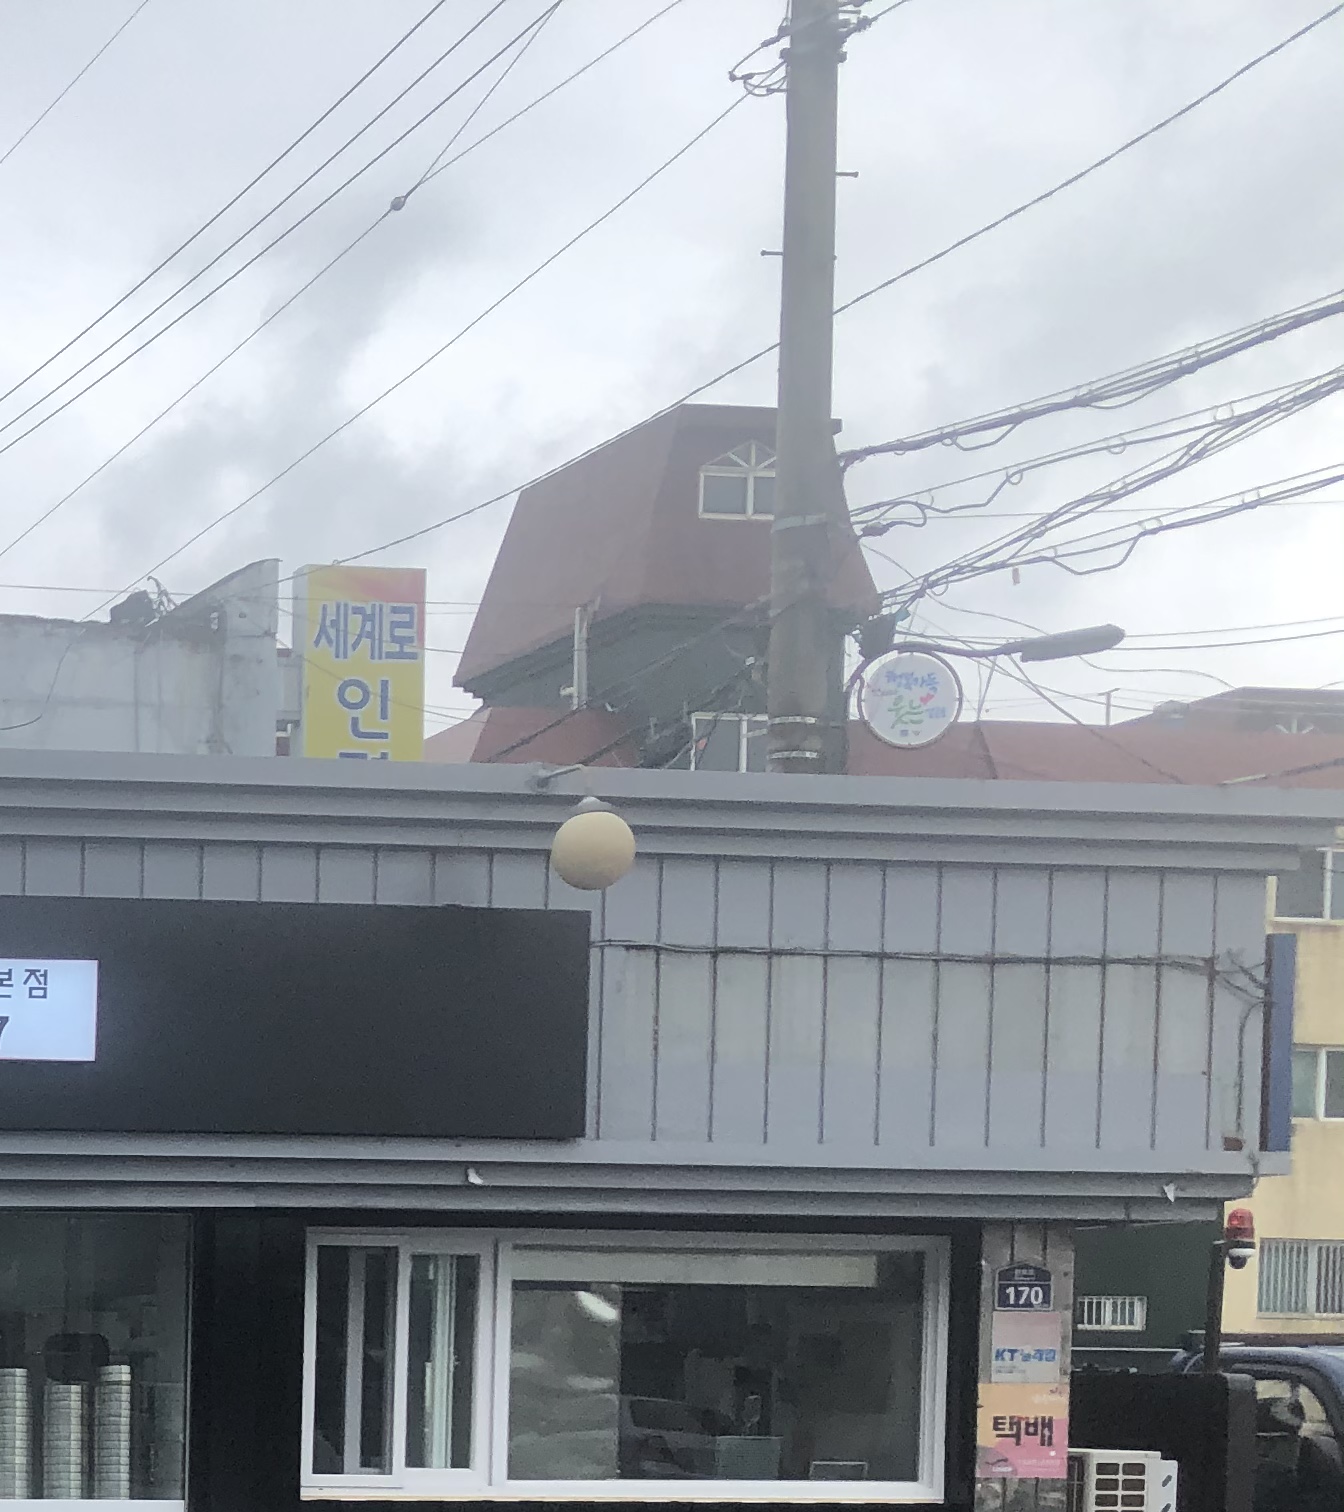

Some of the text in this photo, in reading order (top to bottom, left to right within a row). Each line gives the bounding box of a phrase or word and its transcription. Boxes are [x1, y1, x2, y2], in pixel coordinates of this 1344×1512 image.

[313, 602, 418, 661] 세계로
[337, 678, 389, 760] 인
[1005, 1286, 1044, 1305] 170
[992, 1415, 1054, 1447] 택배
